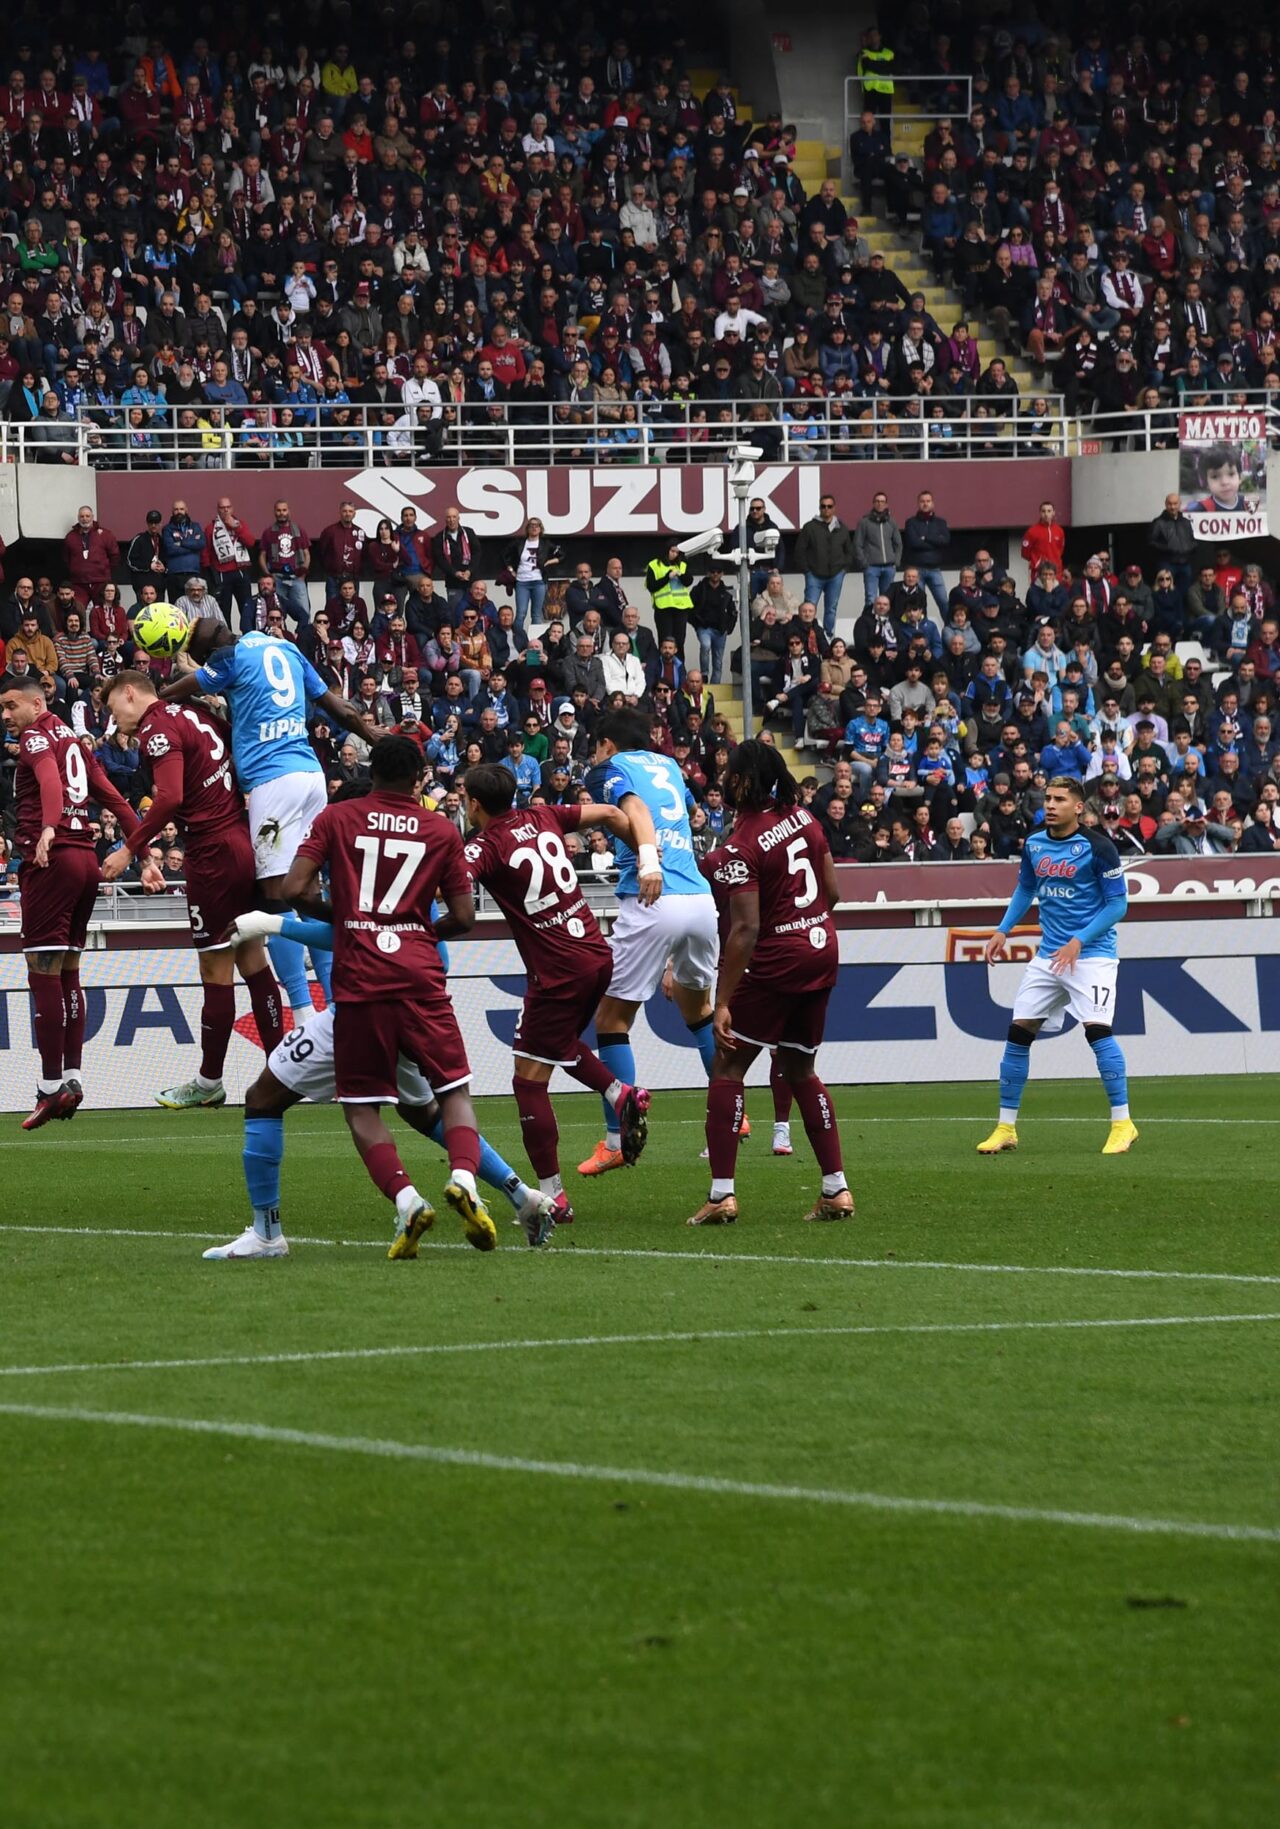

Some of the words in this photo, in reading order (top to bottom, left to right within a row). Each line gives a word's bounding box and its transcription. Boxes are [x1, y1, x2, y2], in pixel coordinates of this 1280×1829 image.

[1185, 416, 1261, 439] MATTEO
[455, 466, 821, 537] SUZUKI
[1198, 519, 1232, 535] CON
[1235, 518, 1262, 535] NOI
[262, 646, 296, 707] 9
[182, 709, 224, 761] 3
[65, 742, 89, 803] 9
[642, 765, 684, 821] 3
[367, 812, 419, 834] SINGO
[757, 809, 813, 852] GRAVILLON
[354, 835, 427, 915] 17
[509, 831, 579, 916] 28
[786, 837, 818, 908] 5
[1035, 856, 1077, 878] Lete
[1046, 886, 1076, 899] MSC
[190, 904, 204, 931] 3
[1091, 985, 1110, 1006] 17
[283, 1025, 314, 1062] 99
